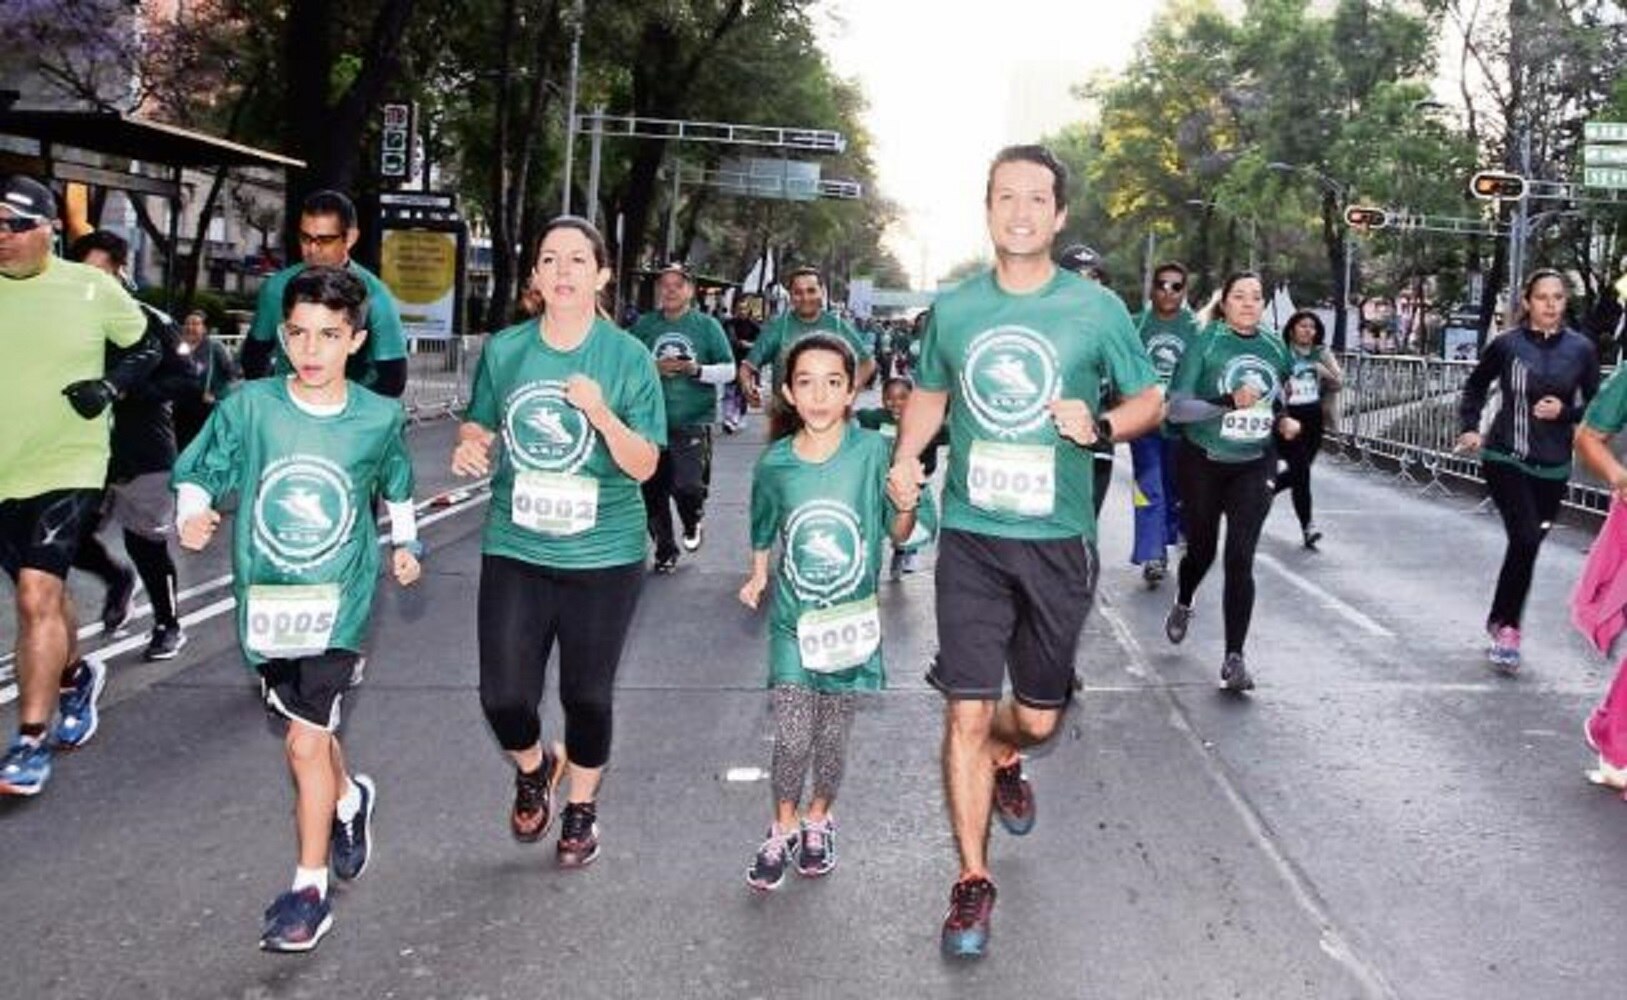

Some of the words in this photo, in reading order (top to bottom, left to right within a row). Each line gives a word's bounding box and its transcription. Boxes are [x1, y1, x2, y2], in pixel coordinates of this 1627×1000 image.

[515, 494, 595, 521] 0002
[251, 612, 333, 635] 0005
[802, 620, 878, 656] 0003
